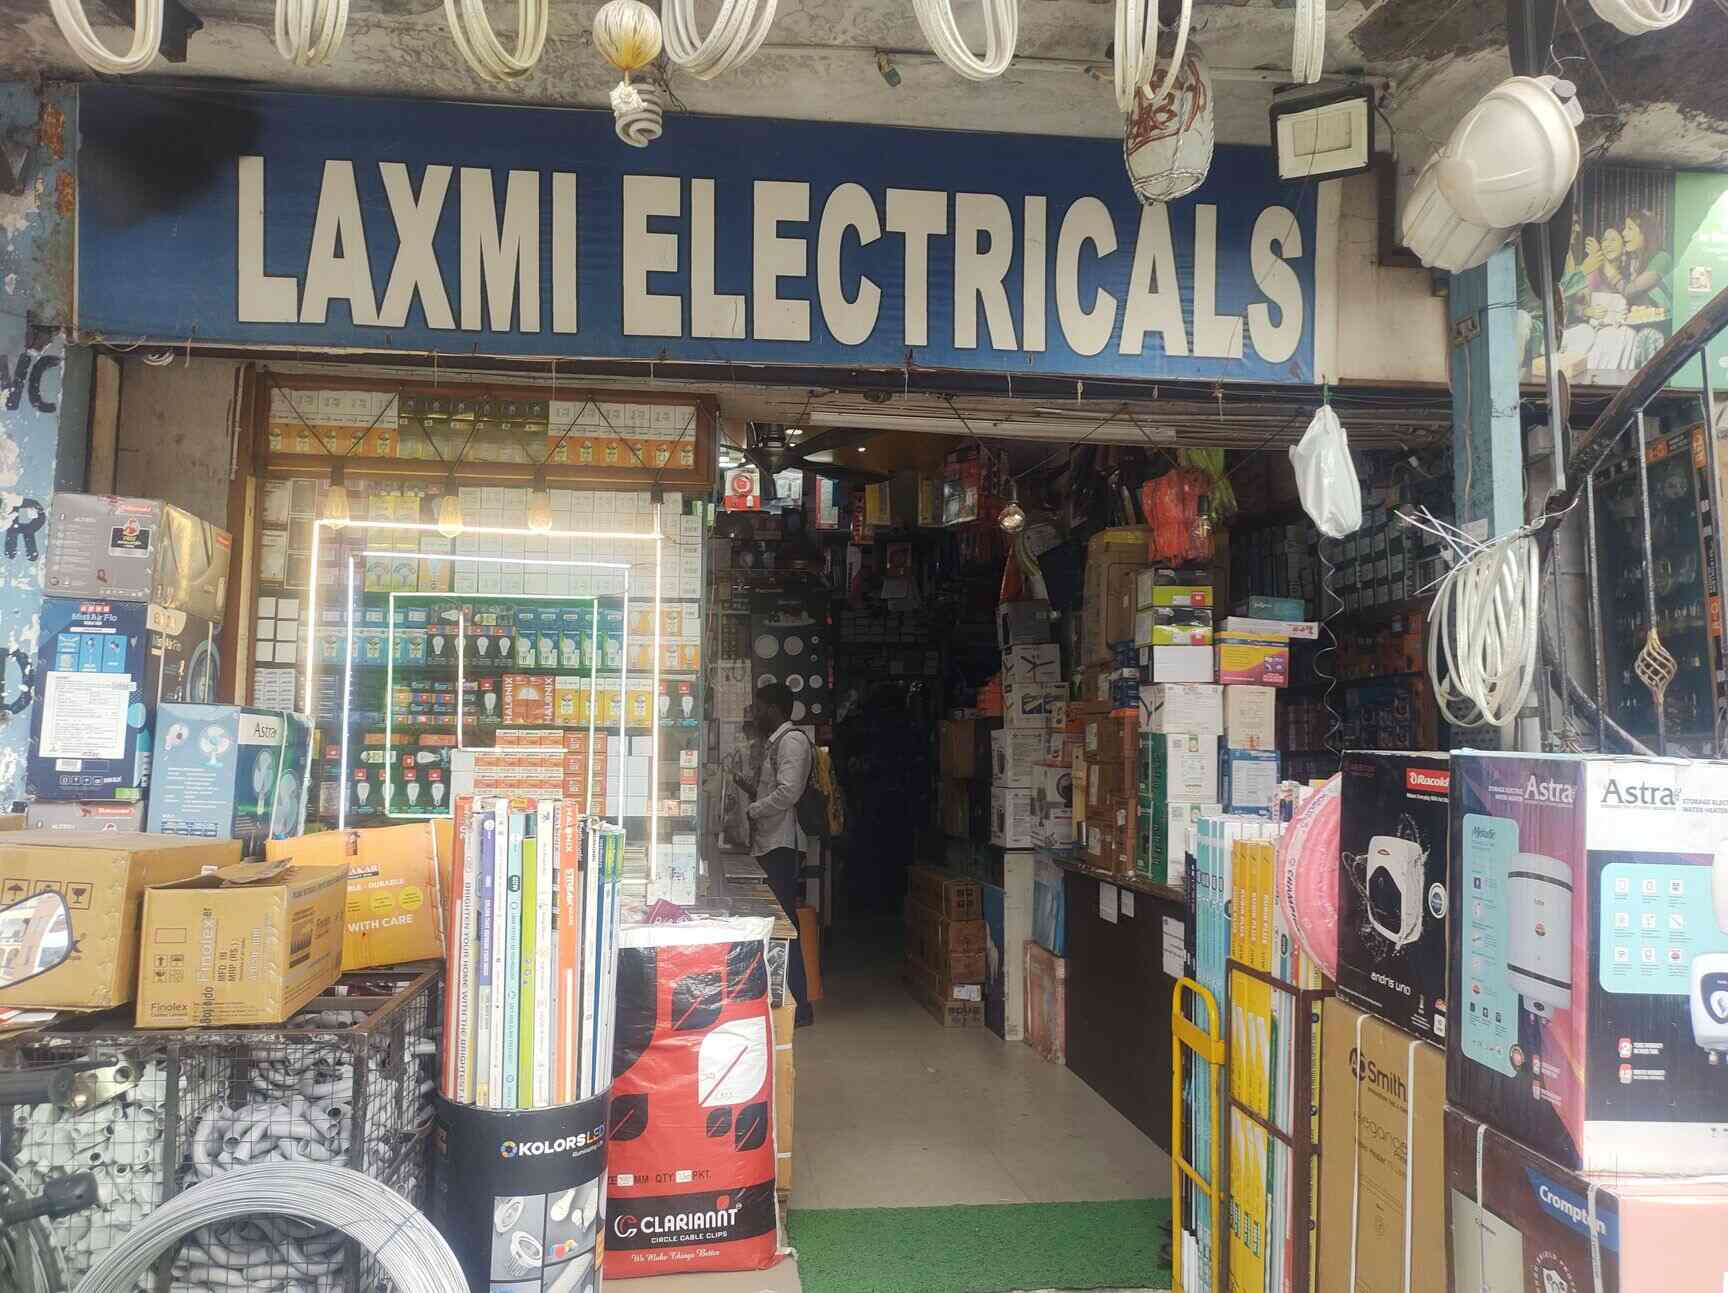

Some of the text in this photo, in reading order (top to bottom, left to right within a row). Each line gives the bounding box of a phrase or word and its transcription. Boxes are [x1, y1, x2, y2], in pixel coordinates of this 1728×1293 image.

[238, 155, 1303, 364] LAXMI ELECTRICALS
[504, 676, 513, 725] HALONIX
[544, 677, 553, 725] HALONIX
[1524, 775, 1573, 803] Astra
[1600, 778, 1676, 806] Astra
[348, 914, 415, 933] WITH CARE
[1395, 981, 1411, 996] uno
[151, 1001, 188, 1013] Finolex
[1367, 1060, 1408, 1102] Smith
[640, 1208, 738, 1234] CLARIANNT
[1539, 1184, 1607, 1236] Cromptn
[651, 1230, 728, 1244] CIRCLE CABLE CLIPS
[696, 1249, 721, 1258] Better
